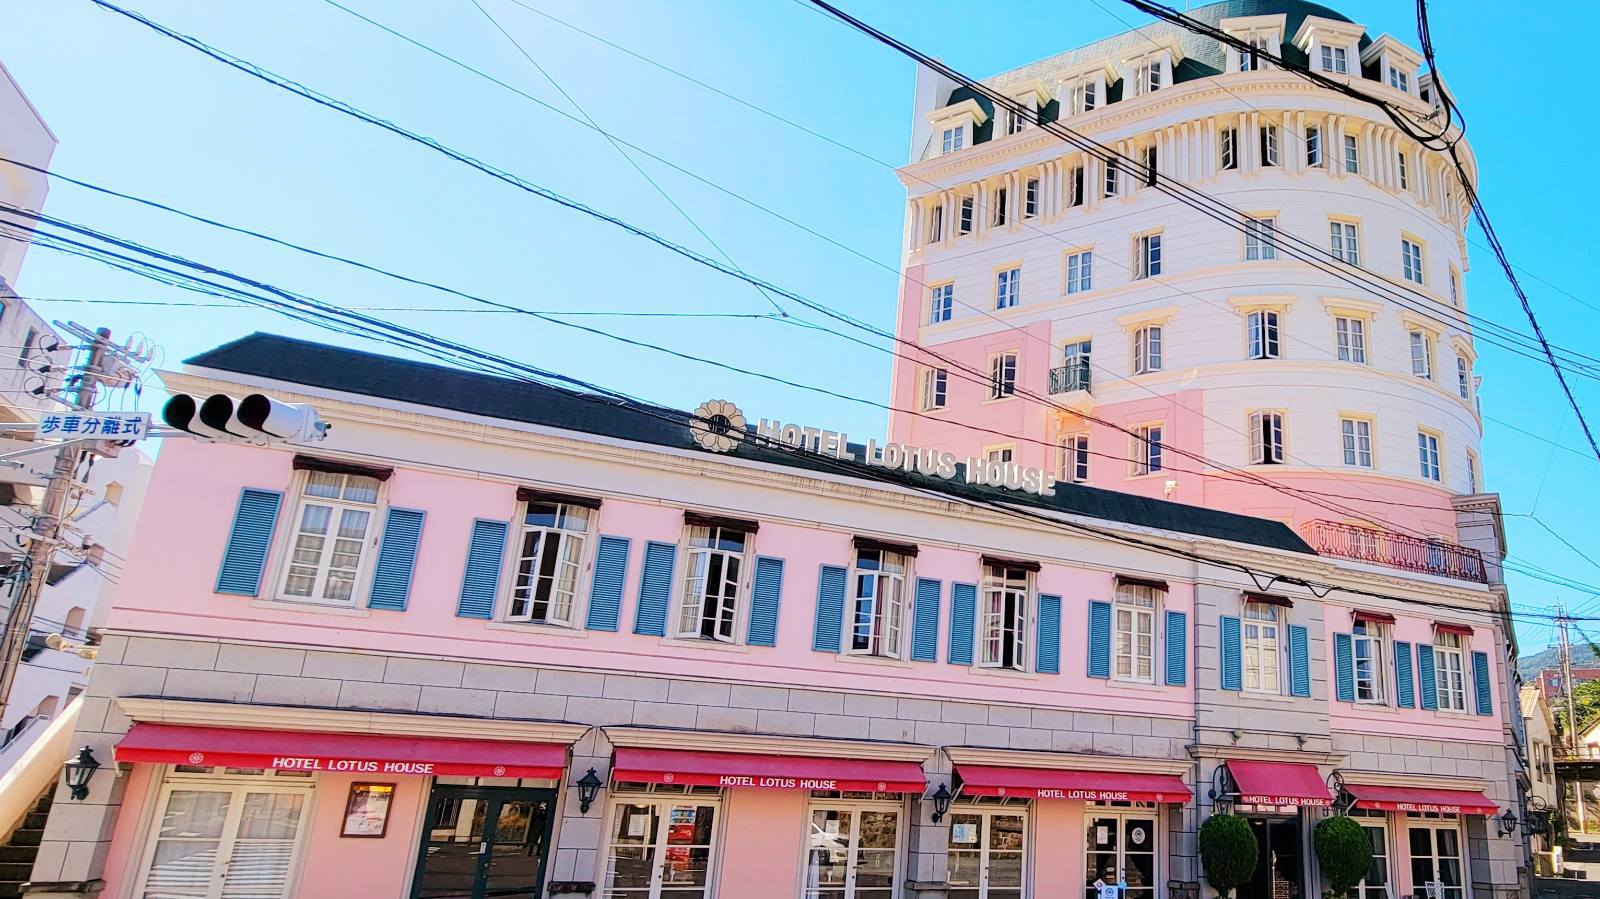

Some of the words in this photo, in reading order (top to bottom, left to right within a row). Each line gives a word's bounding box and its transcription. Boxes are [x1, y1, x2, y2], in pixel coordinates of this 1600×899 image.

[41, 415, 142, 434] 歩車分離式
[756, 418, 856, 462] HOTEL
[866, 438, 957, 479] LOTUS
[966, 456, 1056, 496] HOUSE
[272, 757, 322, 770] HOTEL
[328, 760, 378, 773] LOTUS
[384, 761, 433, 774] HOUSE
[720, 776, 756, 787] HOTEL
[760, 778, 796, 789] LOTUS
[800, 779, 837, 790] HOUSE
[1038, 789, 1065, 798] HOTEL
[1069, 790, 1097, 800] LOTUS
[1100, 791, 1128, 801] HOUSE
[1250, 795, 1273, 804] HOTEL
[1275, 796, 1299, 805] LOTUS
[1301, 798, 1325, 806] HOUSE
[1397, 803, 1418, 811] HOTEL
[1419, 804, 1439, 812] LOTUS
[1441, 804, 1461, 813] HOUSE
